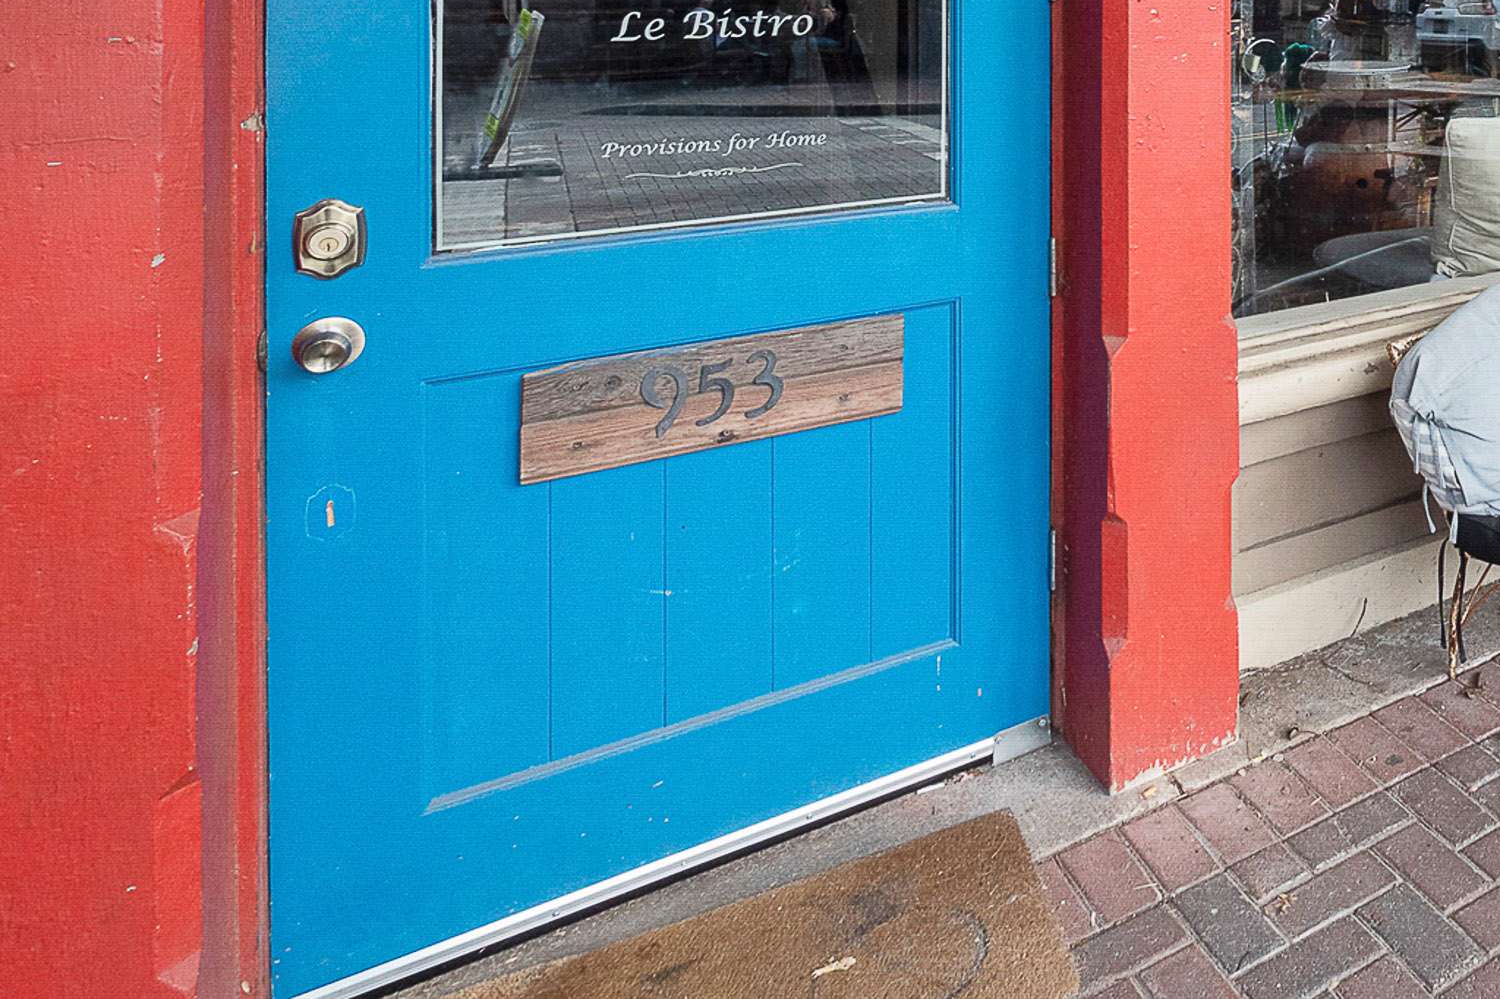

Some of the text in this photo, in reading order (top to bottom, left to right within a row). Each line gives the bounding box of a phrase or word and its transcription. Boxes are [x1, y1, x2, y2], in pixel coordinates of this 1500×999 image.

[610, 8, 814, 42] Le Bistro
[601, 130, 827, 158] Provisions for Home
[639, 349, 784, 438] 953
